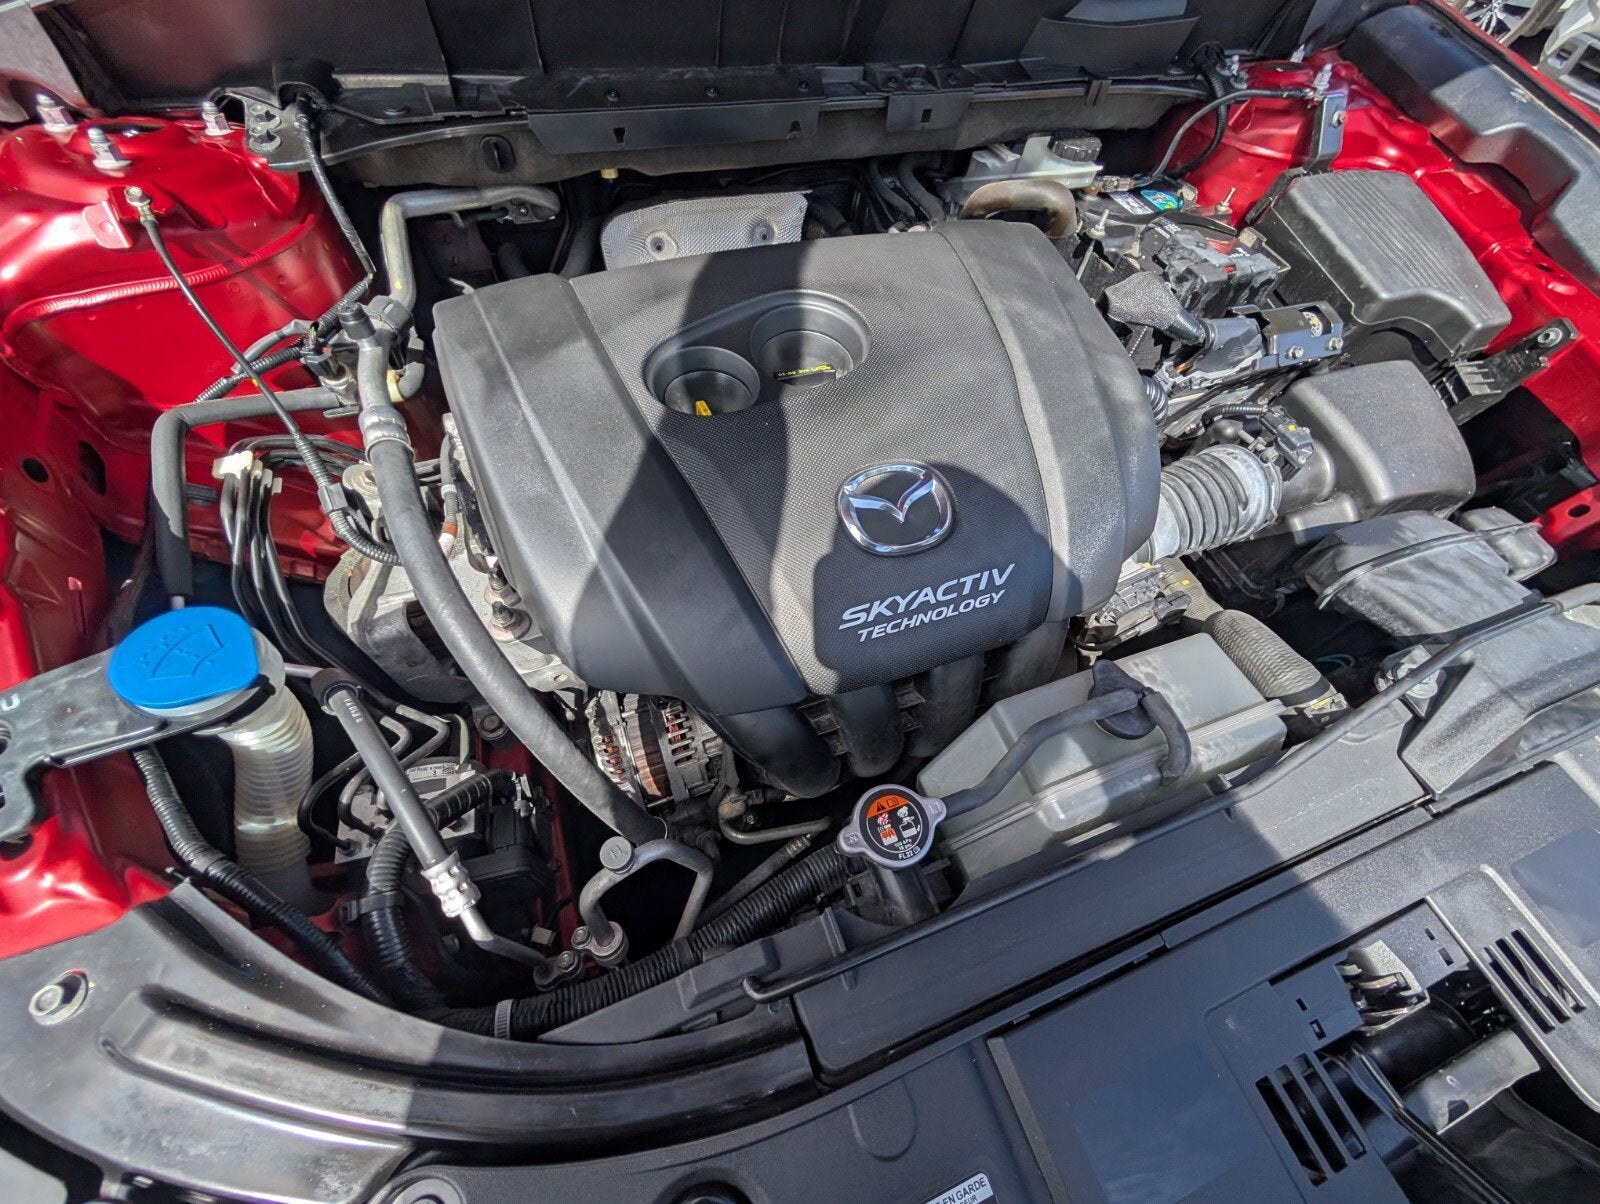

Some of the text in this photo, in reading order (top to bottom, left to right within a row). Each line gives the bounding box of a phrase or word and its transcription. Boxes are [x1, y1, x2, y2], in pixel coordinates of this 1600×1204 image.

[838, 563, 1015, 630] SKYACTIV
[857, 589, 1005, 642] TECHNOLOGY
[898, 850, 914, 860] FL22
[955, 1177, 987, 1201] GARDE
